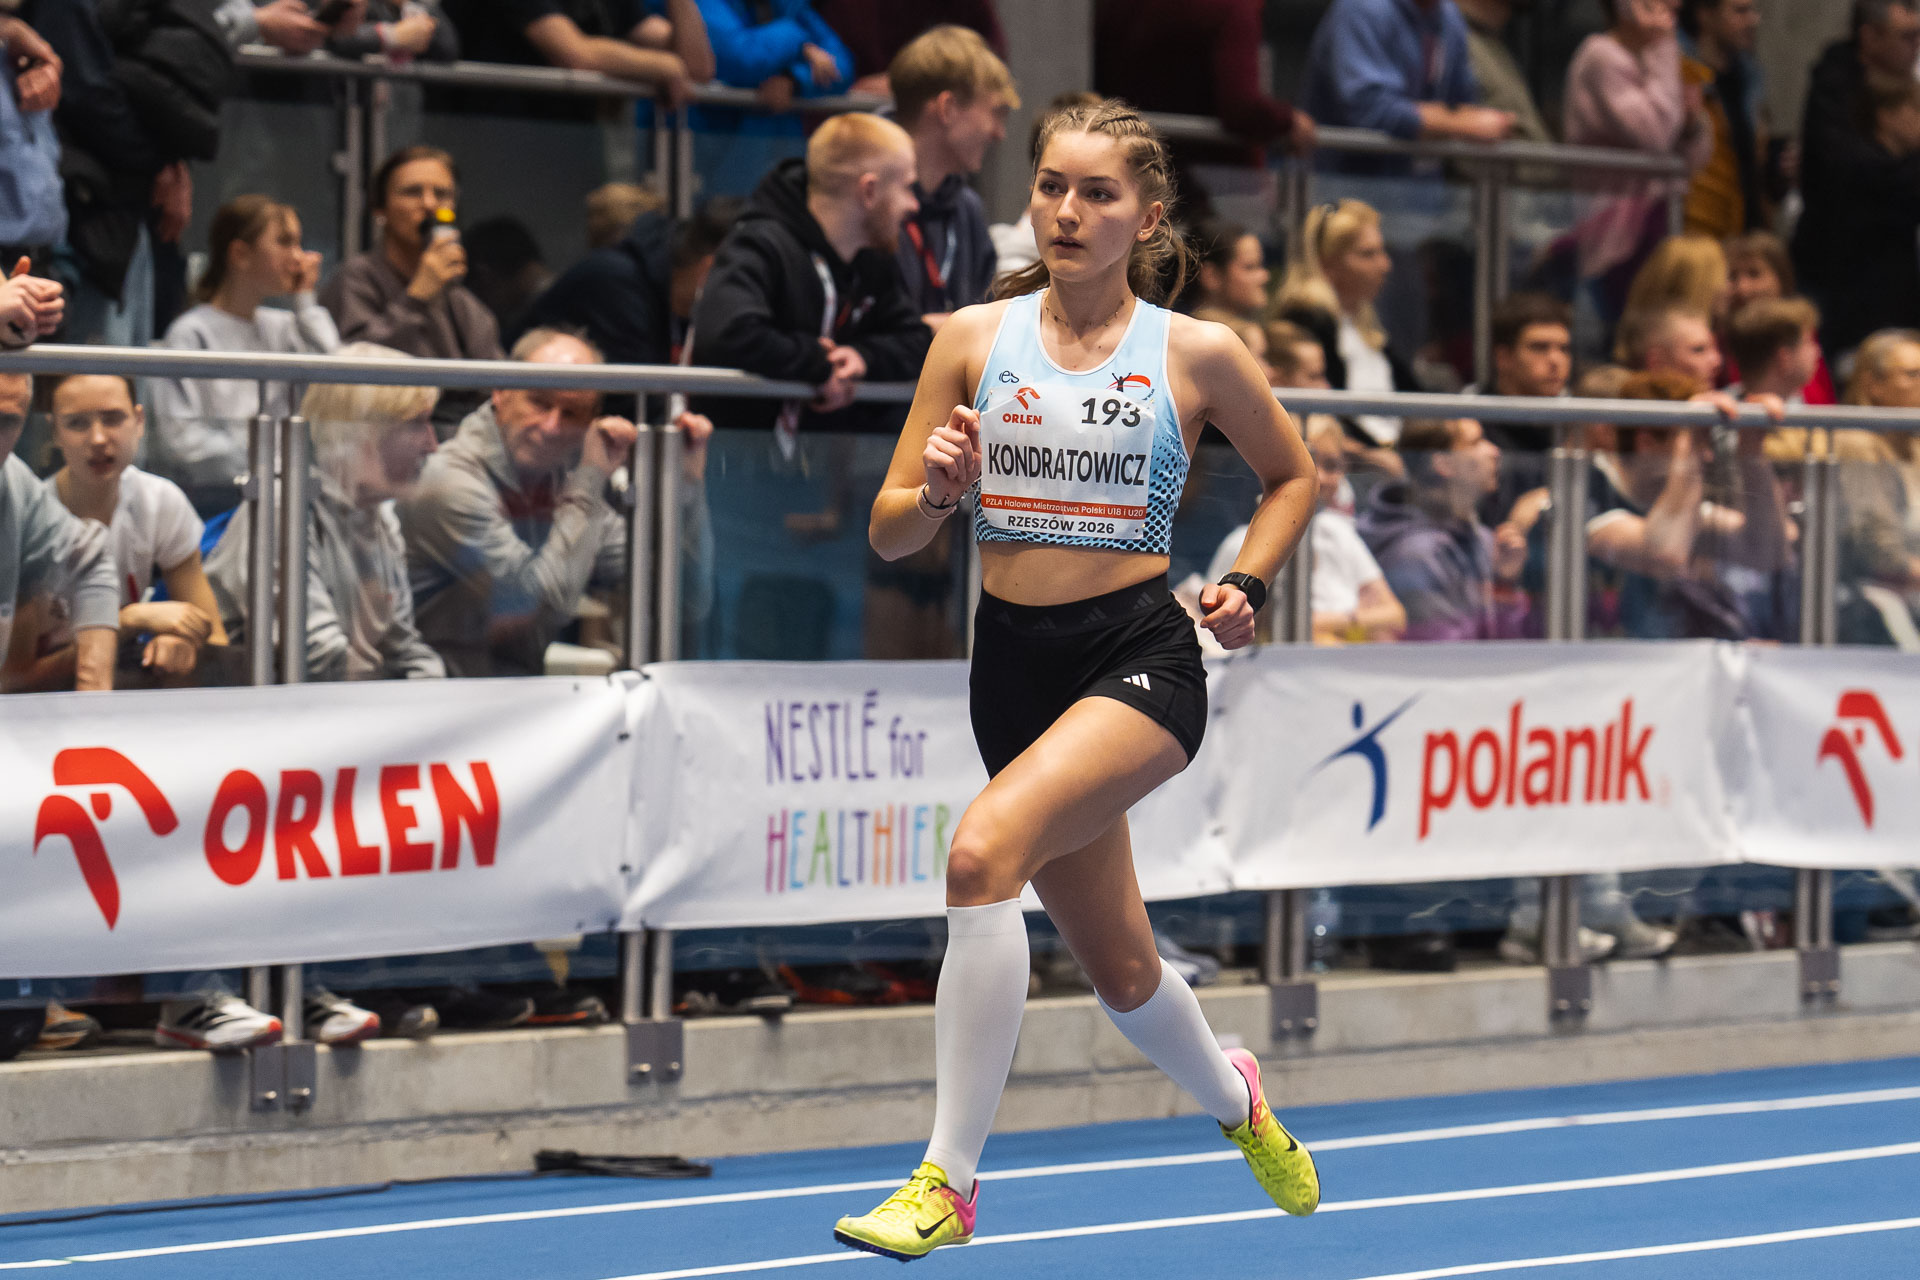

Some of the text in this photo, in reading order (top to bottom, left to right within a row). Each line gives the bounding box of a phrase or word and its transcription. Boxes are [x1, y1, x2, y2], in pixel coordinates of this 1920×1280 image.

[1002, 412, 1043, 425] ORLEN
[1081, 397, 1141, 428] 193
[988, 442, 1147, 486] KONDRATOWICZ
[985, 497, 1003, 506] PZLA
[1004, 499, 1032, 509] Halowe
[1033, 501, 1079, 513] Mistrzostwa
[1081, 505, 1106, 515] Polski
[1107, 507, 1122, 516] U18
[1128, 509, 1144, 517] U20
[1007, 515, 1115, 534] RZESZÓW 2026
[765, 689, 928, 786] NESTLÉ for
[1418, 696, 1656, 842] polanik
[204, 761, 500, 886] ORLEN
[765, 803, 948, 893] HEALTHIER
